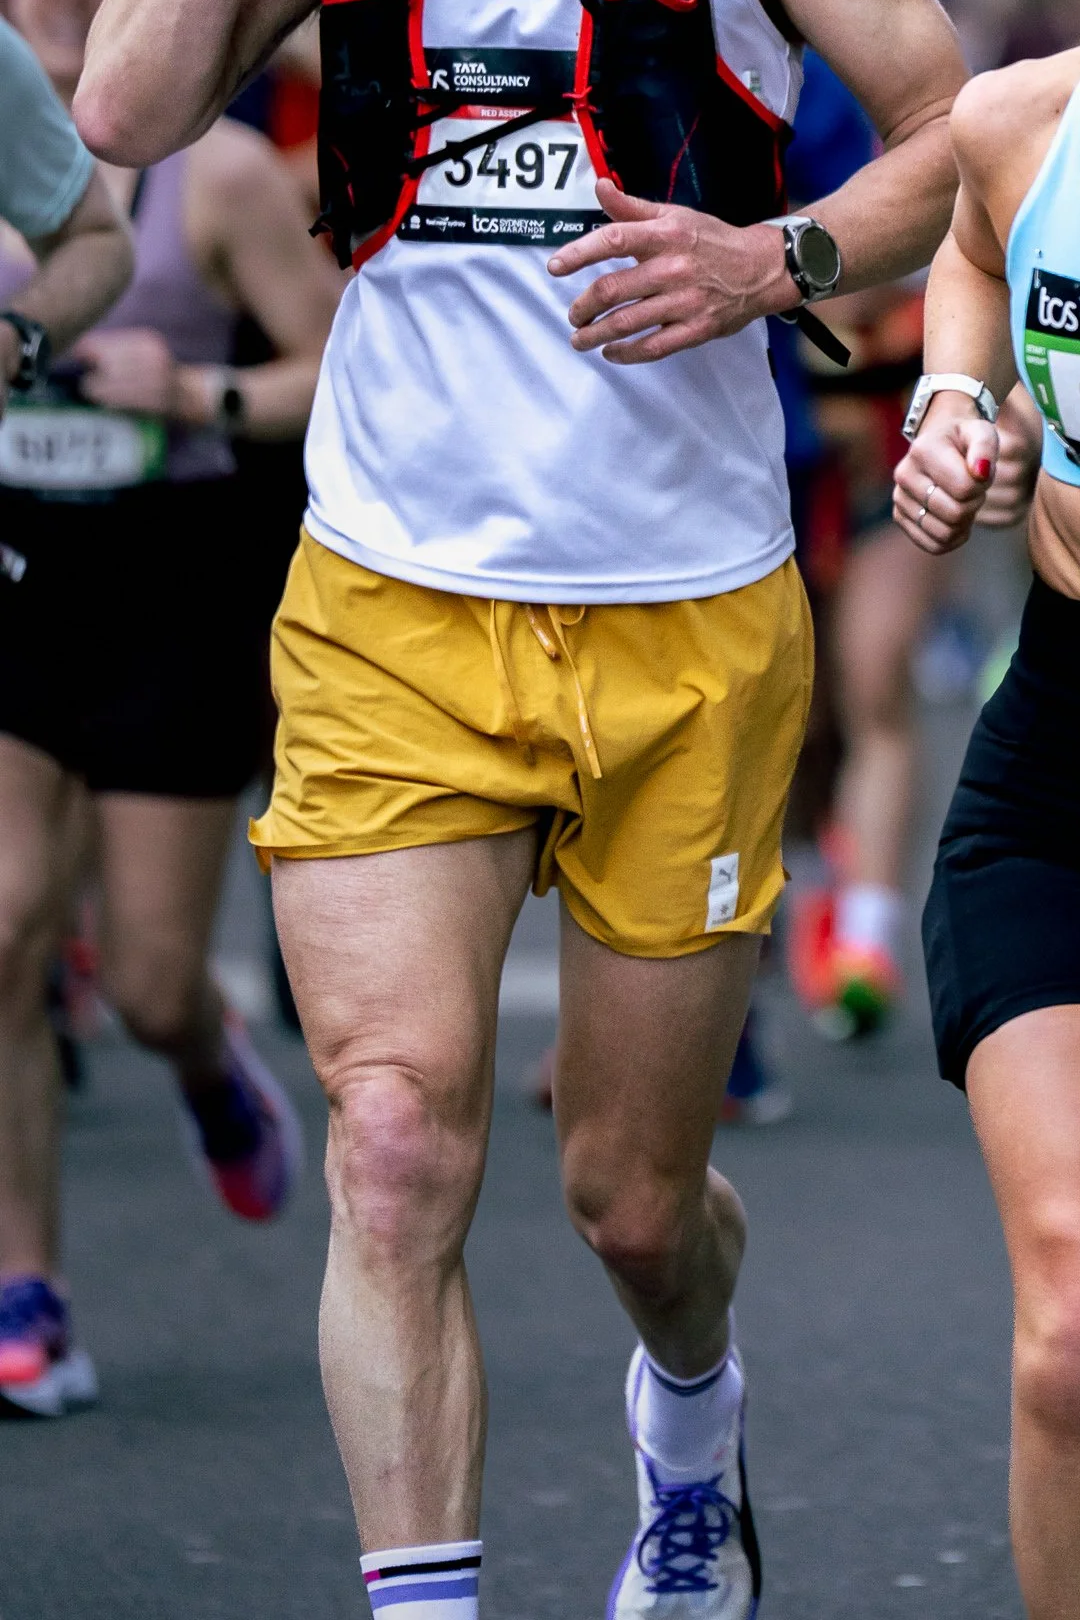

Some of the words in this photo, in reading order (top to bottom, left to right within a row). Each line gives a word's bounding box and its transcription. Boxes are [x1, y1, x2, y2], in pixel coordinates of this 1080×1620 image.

[452, 62, 487, 74] TATA
[453, 75, 531, 87] CONSULTANCY
[481, 109, 497, 118] RED
[472, 214, 499, 233] tcs
[499, 218, 529, 227] SYDNEY
[499, 226, 545, 234] MARATHON
[1038, 286, 1079, 332] tcs
